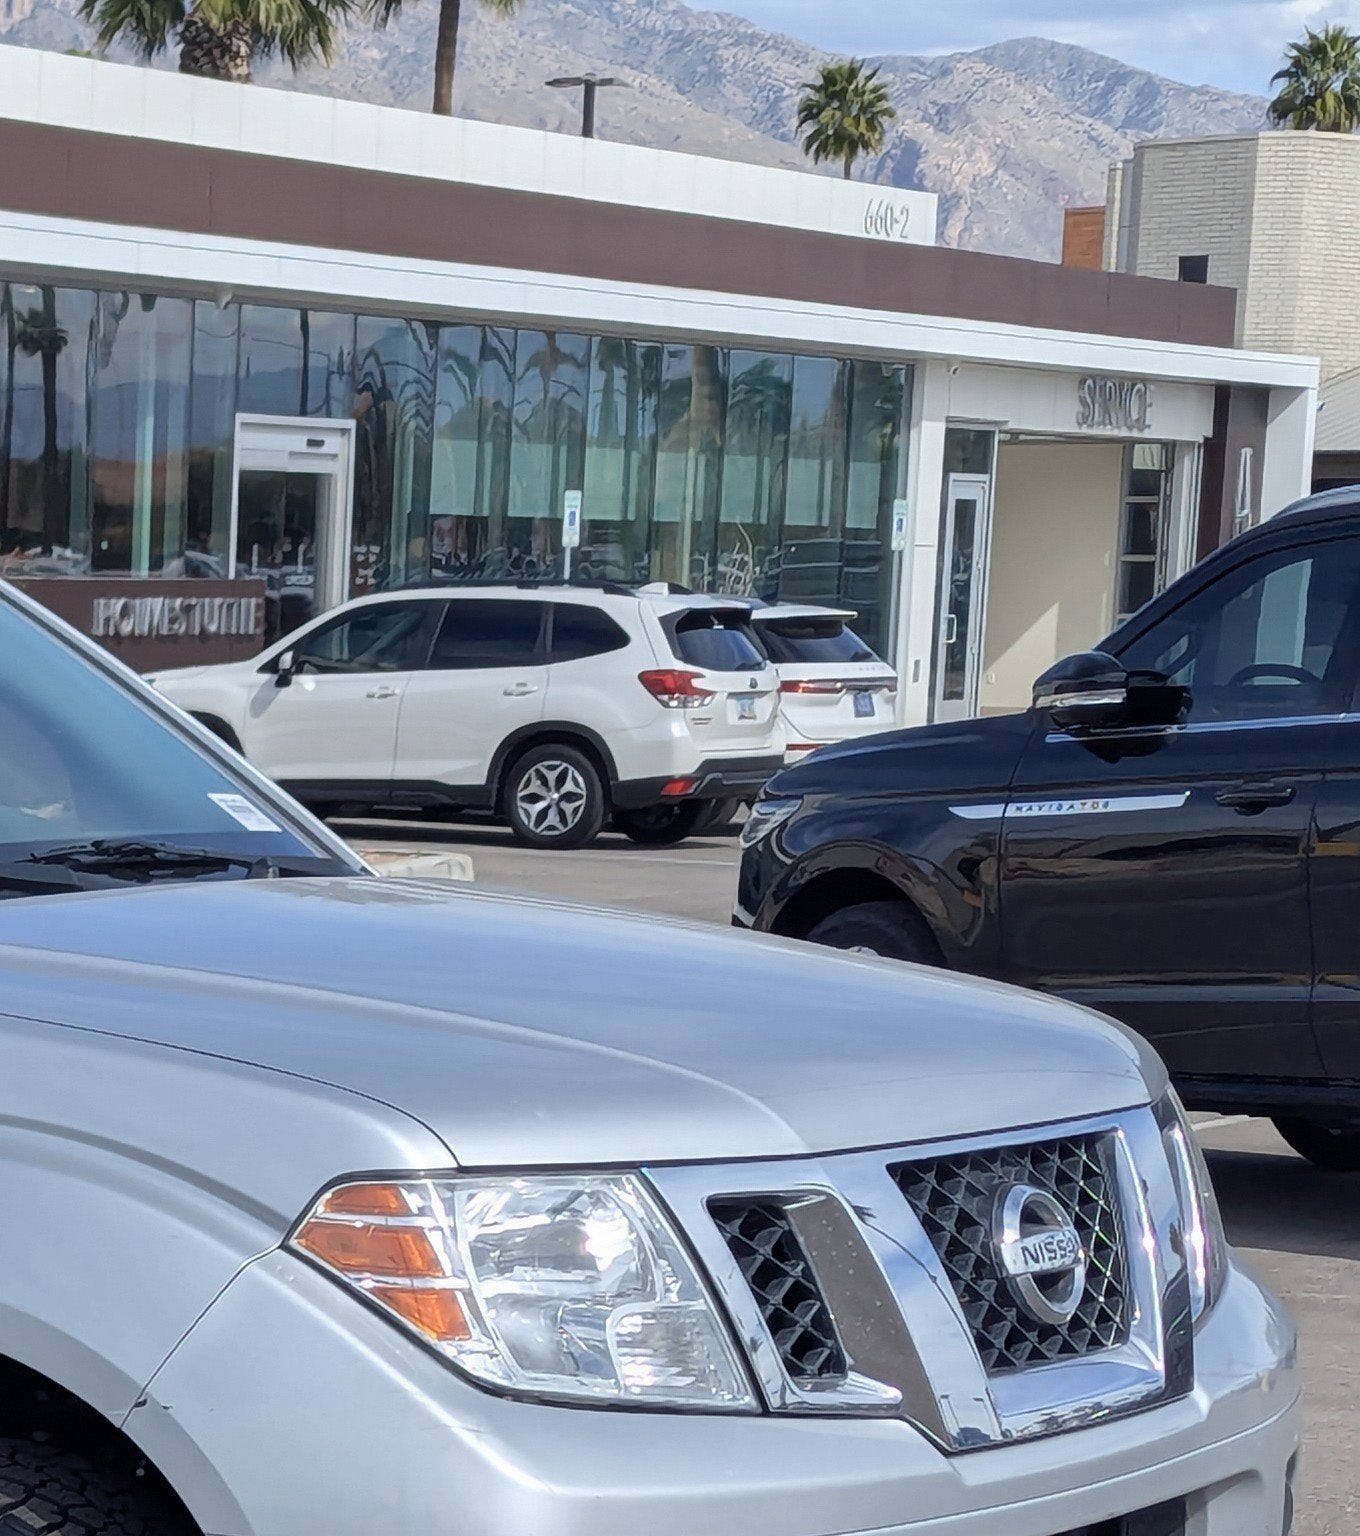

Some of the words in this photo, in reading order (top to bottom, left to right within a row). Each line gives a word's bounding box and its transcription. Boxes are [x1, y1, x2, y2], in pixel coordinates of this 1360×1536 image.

[864, 198, 909, 239] 660-2
[1077, 378, 1152, 432] SERVICE
[1015, 801, 1110, 813] NAVIGATOR
